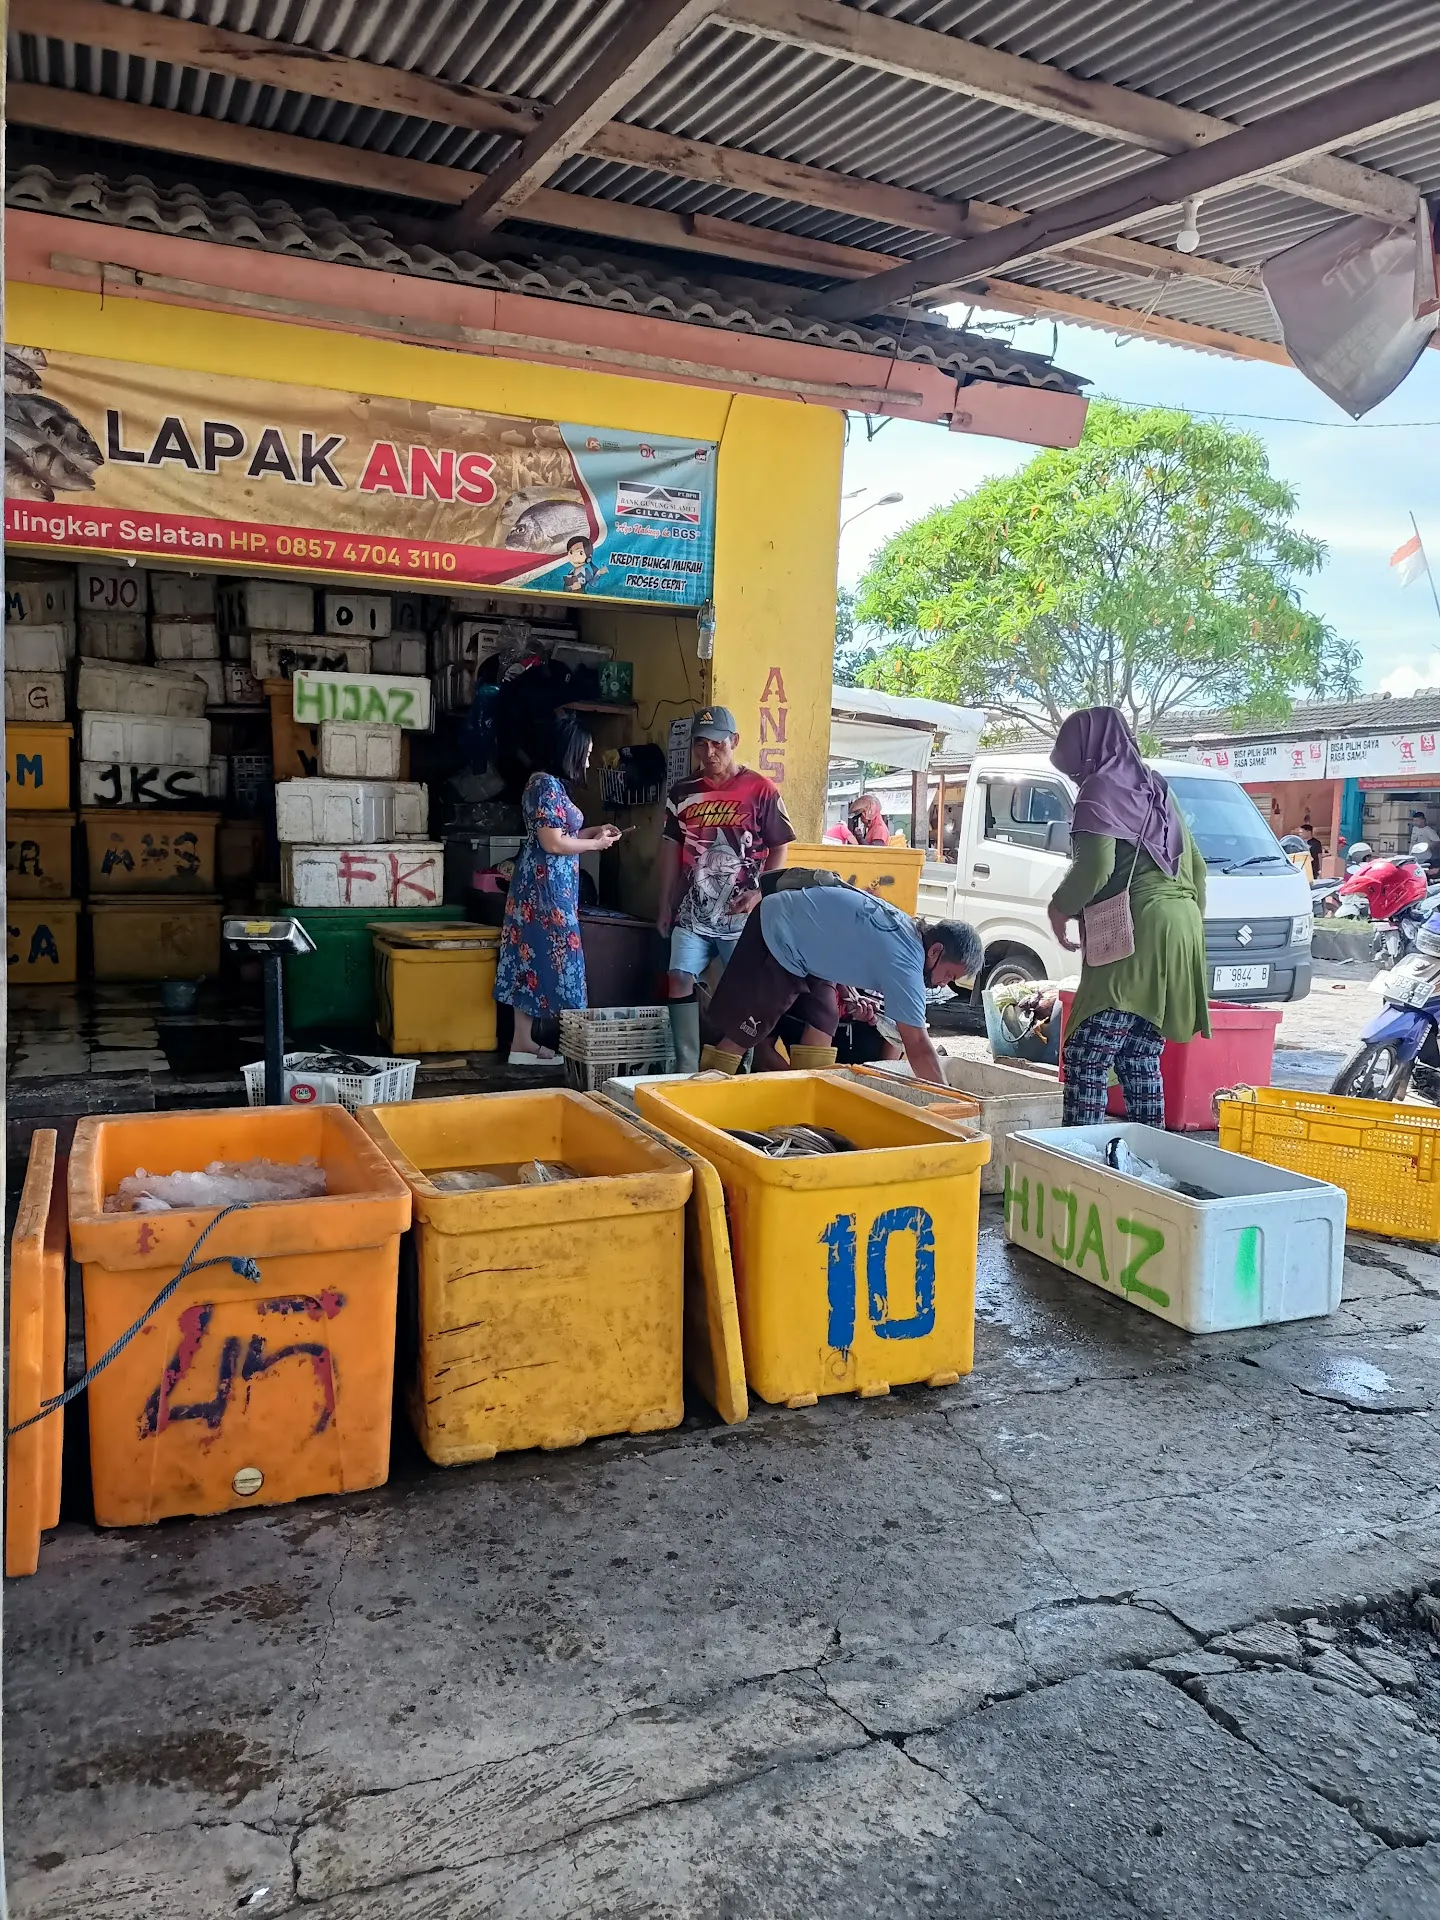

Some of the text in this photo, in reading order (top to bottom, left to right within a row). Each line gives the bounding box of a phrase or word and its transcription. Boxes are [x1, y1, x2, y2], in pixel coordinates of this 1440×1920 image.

[105, 408, 497, 507] LAPAK ANS
[620, 497, 696, 513] BANK GUNUNG SLAMET
[635, 508, 681, 520] CILACAP
[119, 520, 223, 548] Selatan
[230, 530, 269, 553] HP.
[276, 535, 336, 559] 0857
[343, 543, 401, 566] 4704
[407, 549, 456, 572] 3110
[610, 552, 703, 573] KREDIT BUNGA MURAH
[89, 576, 138, 607] PJO
[626, 574, 687, 591] PROSES CEPAT
[27, 686, 49, 709] G
[296, 676, 416, 727] HIJAZ
[758, 666, 788, 784] ANS
[338, 852, 437, 907] FK
[1003, 1164, 1171, 1308] HIJAZ
[818, 1206, 936, 1352] 10
